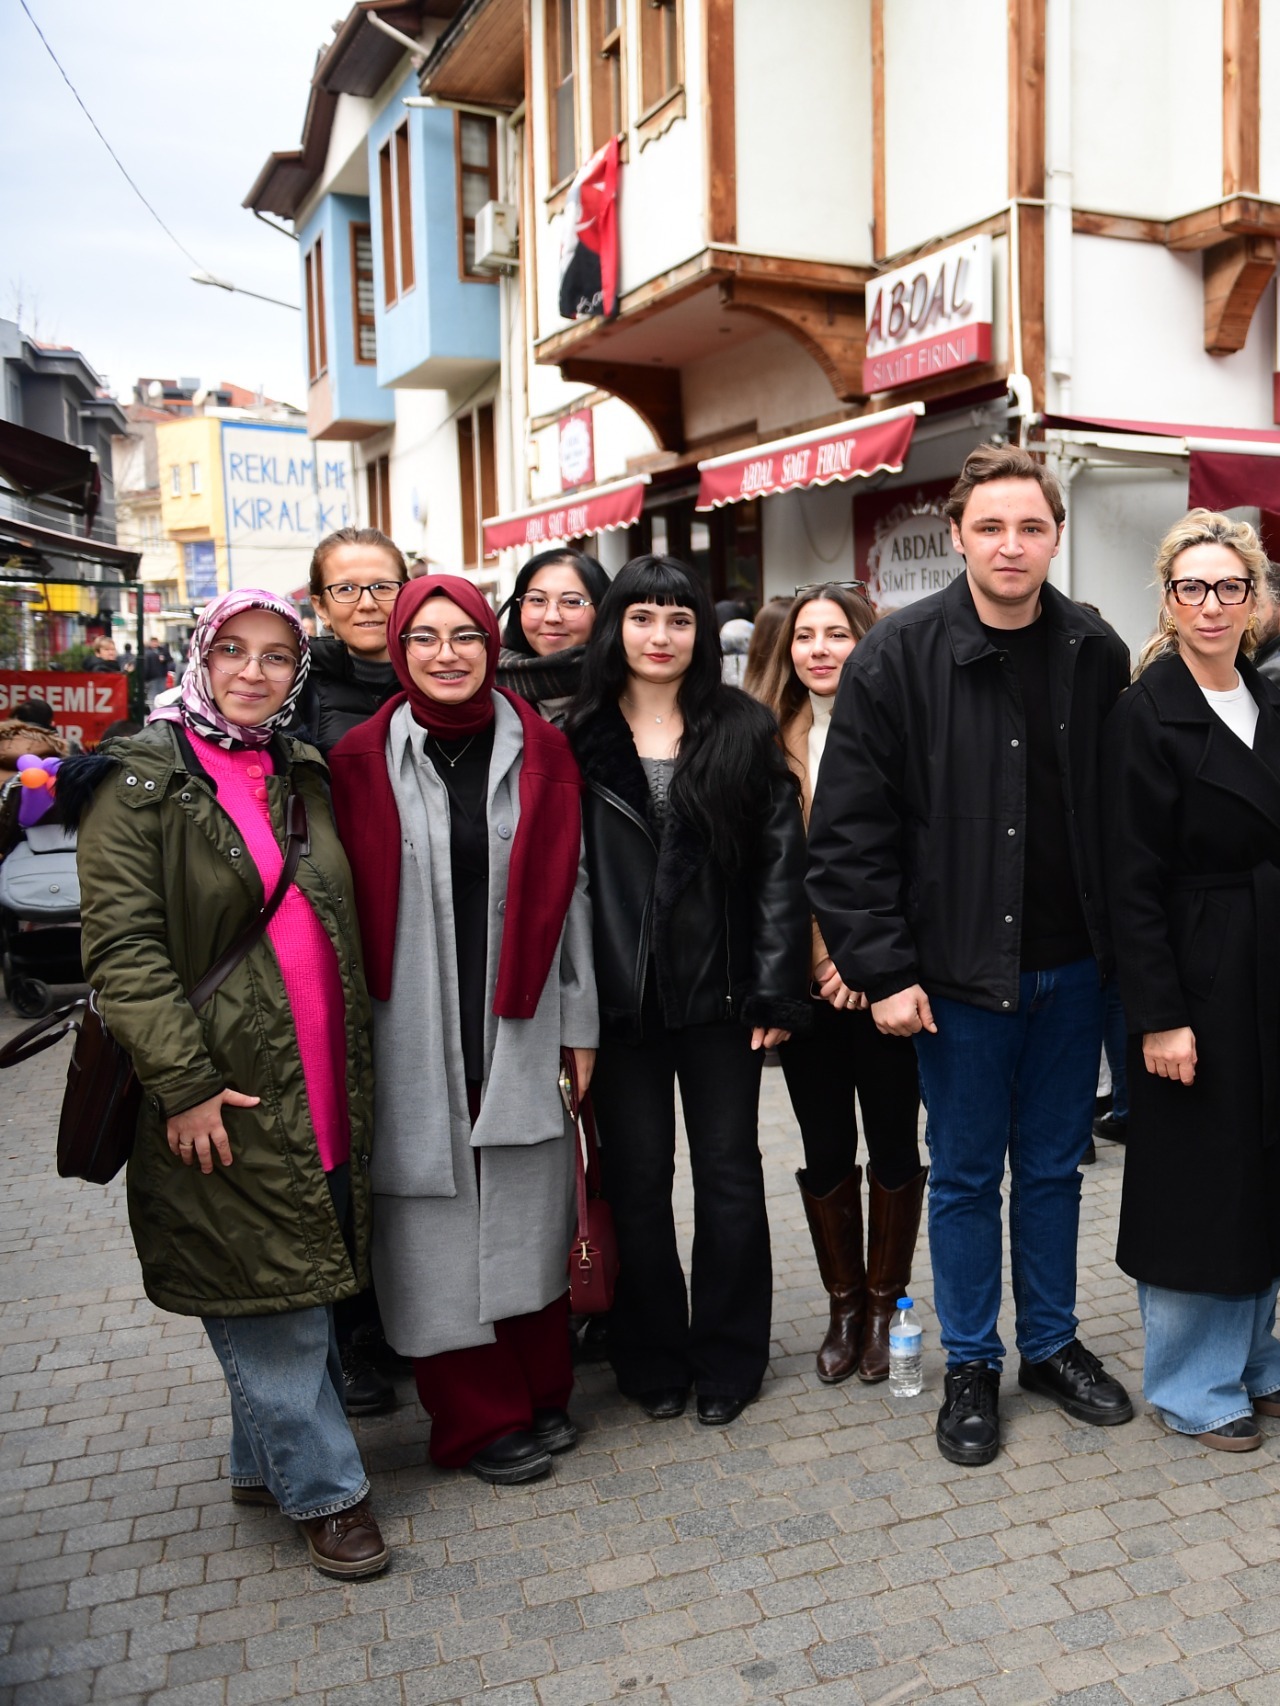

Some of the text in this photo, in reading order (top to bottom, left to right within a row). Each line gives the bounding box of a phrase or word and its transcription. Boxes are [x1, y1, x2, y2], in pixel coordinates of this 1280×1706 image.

[866, 256, 973, 345] ABDAL
[918, 336, 966, 374] FIRINI
[741, 459, 774, 492] ABDAL
[891, 531, 948, 562] ABDAL
[881, 568, 916, 592] SİMİT
